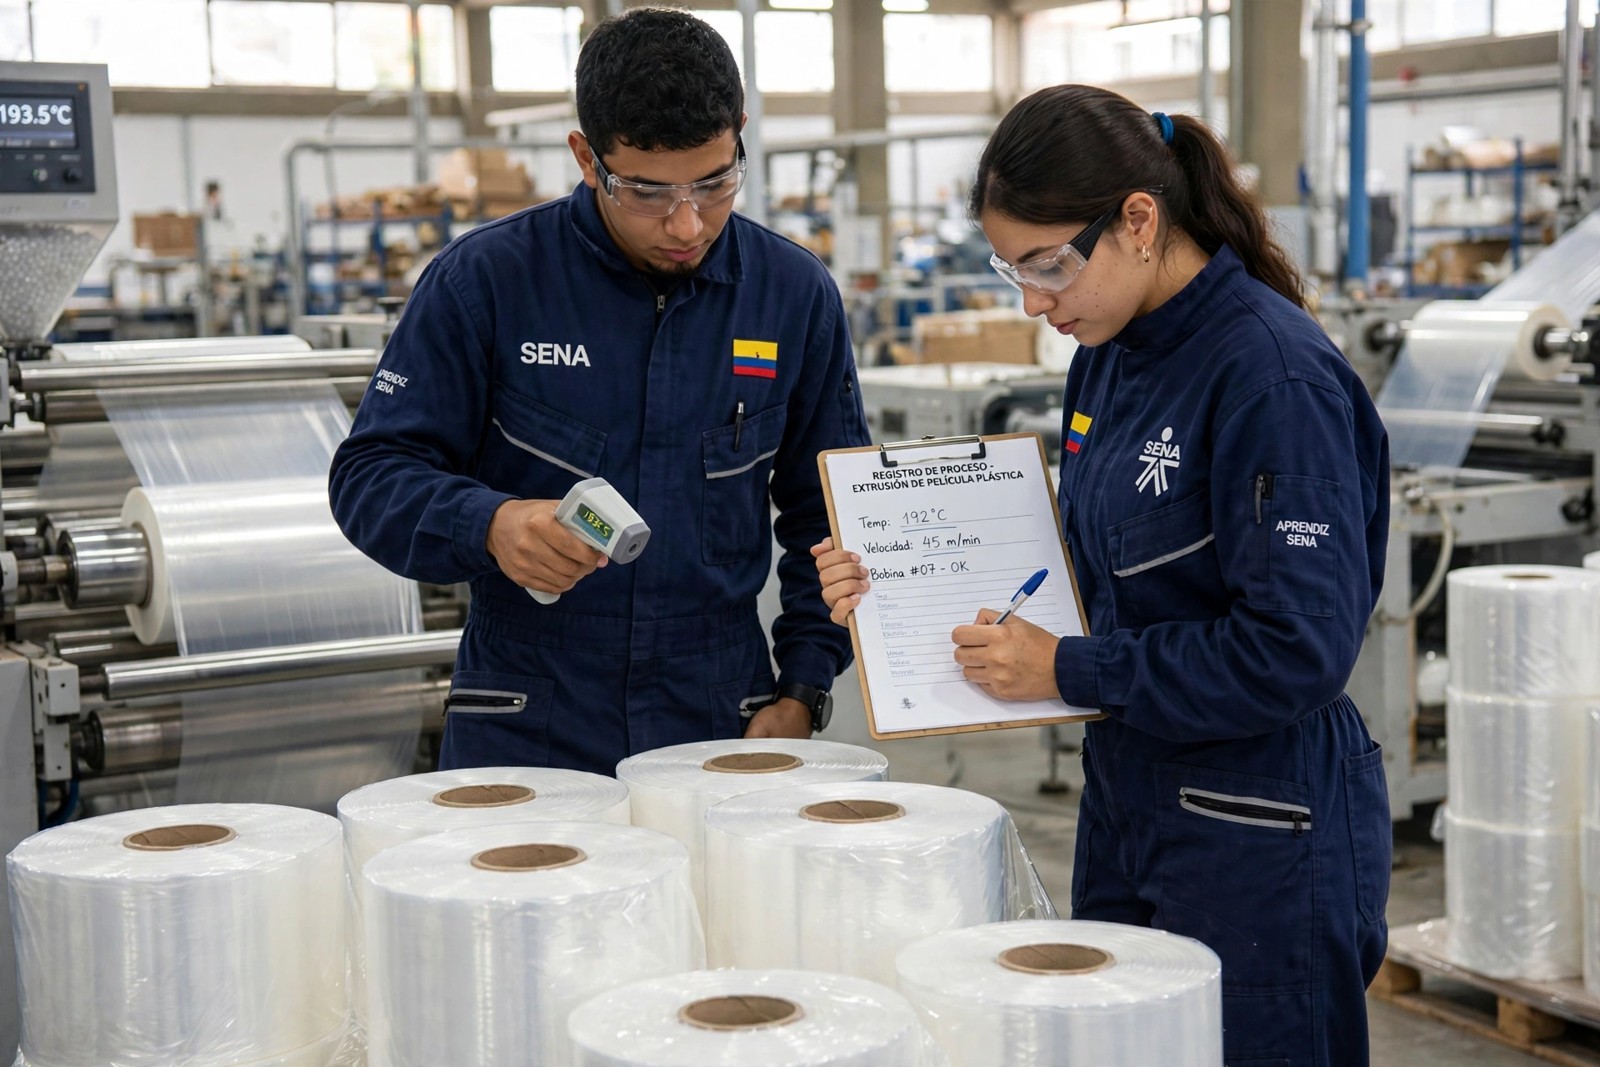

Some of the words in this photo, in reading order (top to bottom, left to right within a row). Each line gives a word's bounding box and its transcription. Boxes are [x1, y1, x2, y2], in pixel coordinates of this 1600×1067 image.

[520, 341, 591, 367] SENA
[375, 380, 394, 395] SENA
[376, 368, 409, 388] APRENDIZ
[1143, 440, 1181, 460] SENA
[872, 468, 923, 480] REGISTRO
[925, 466, 939, 476] DE
[940, 462, 987, 474] PROCESO
[852, 478, 909, 493] EXTRUSIÓN
[910, 478, 925, 488] DE
[927, 475, 975, 487] PELÍCULA
[976, 470, 1024, 483] PLÁSTICA
[858, 516, 891, 531] Temp:
[902, 507, 947, 525] 192°C
[1275, 520, 1330, 536] APRENDIZ
[863, 540, 913, 554] Velocidad:
[922, 535, 940, 548] 45
[946, 533, 981, 547] m/min
[1286, 534, 1318, 548] SENA
[870, 566, 905, 581] Bobina
[910, 563, 937, 576] #07
[951, 561, 970, 573] OK
